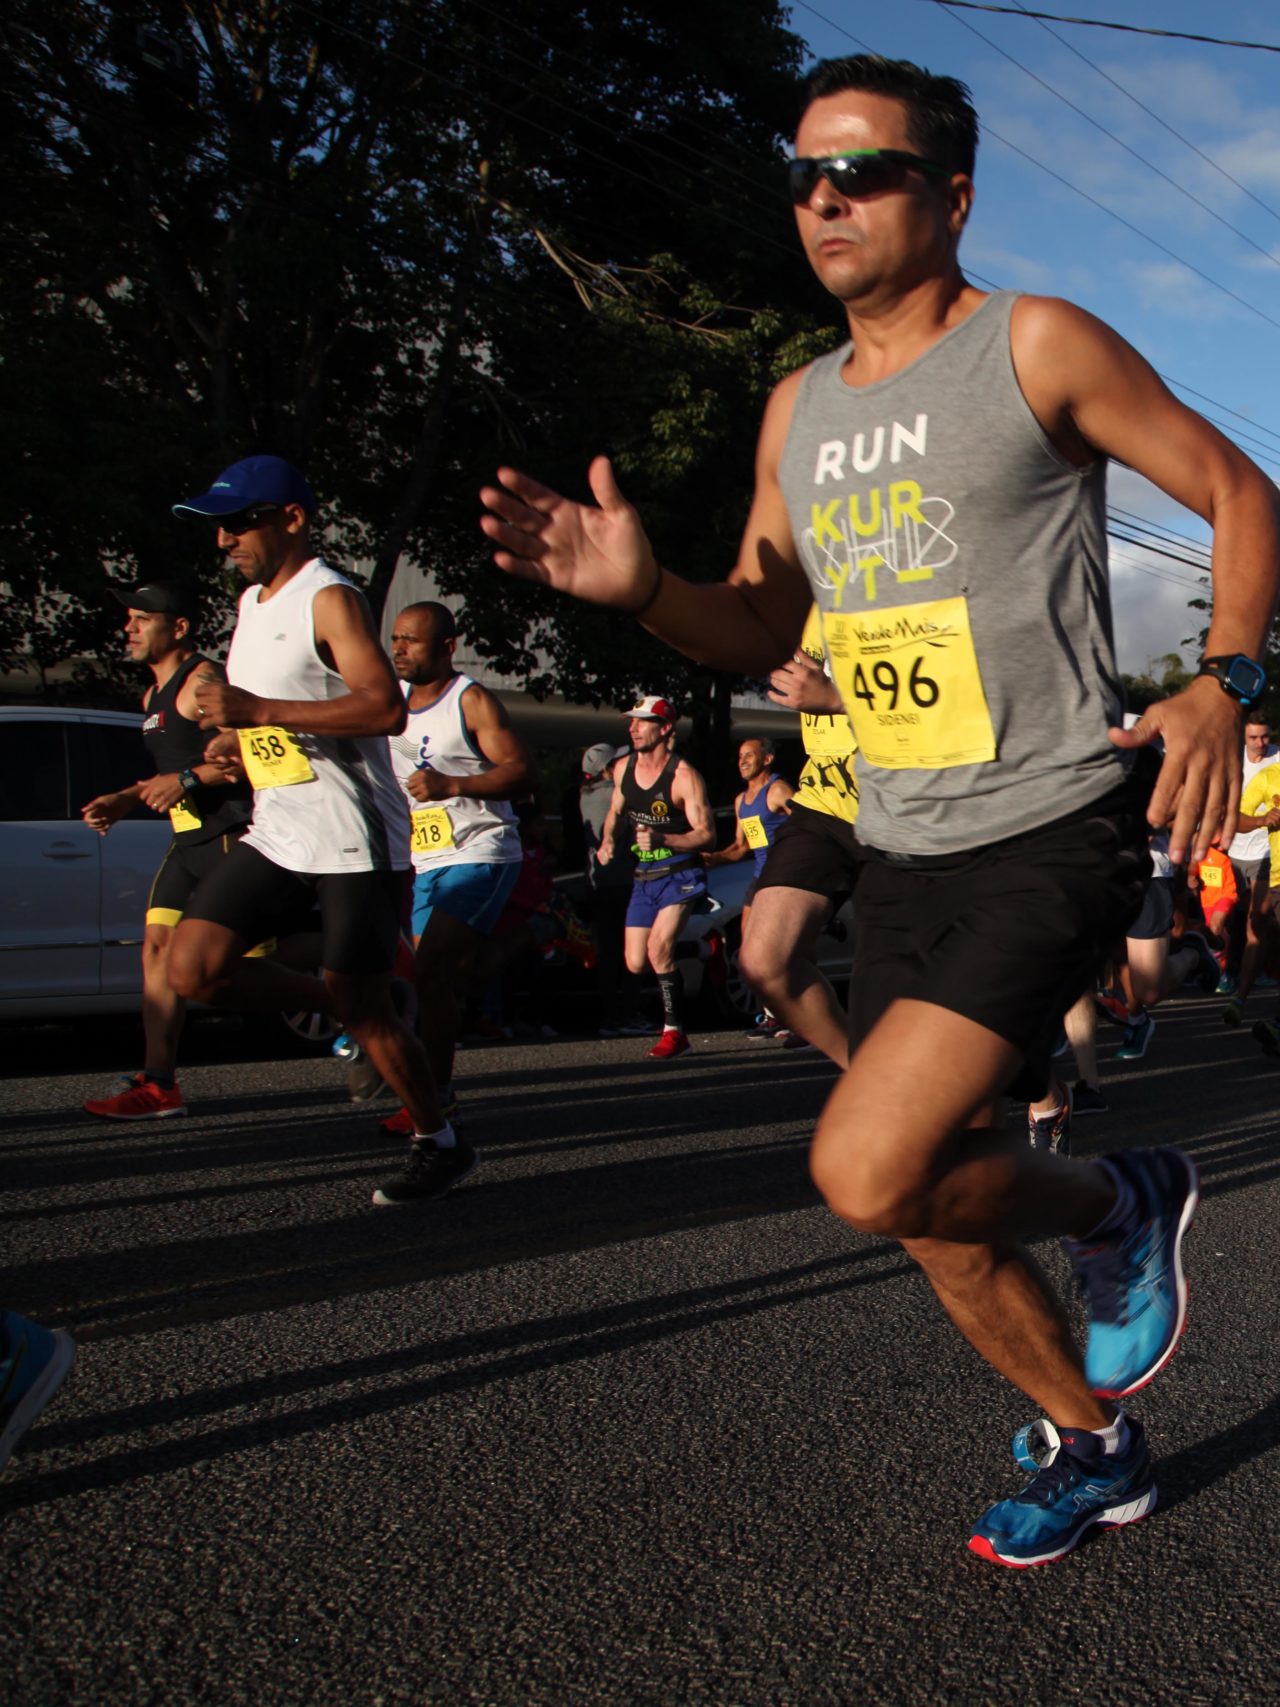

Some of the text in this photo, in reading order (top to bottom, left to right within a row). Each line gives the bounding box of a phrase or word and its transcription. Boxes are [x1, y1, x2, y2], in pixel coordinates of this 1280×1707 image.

[814, 413, 928, 485] RUN
[811, 480, 926, 547] KUR
[853, 656, 939, 711] 496
[250, 735, 286, 761] 458
[414, 825, 441, 846] 318
